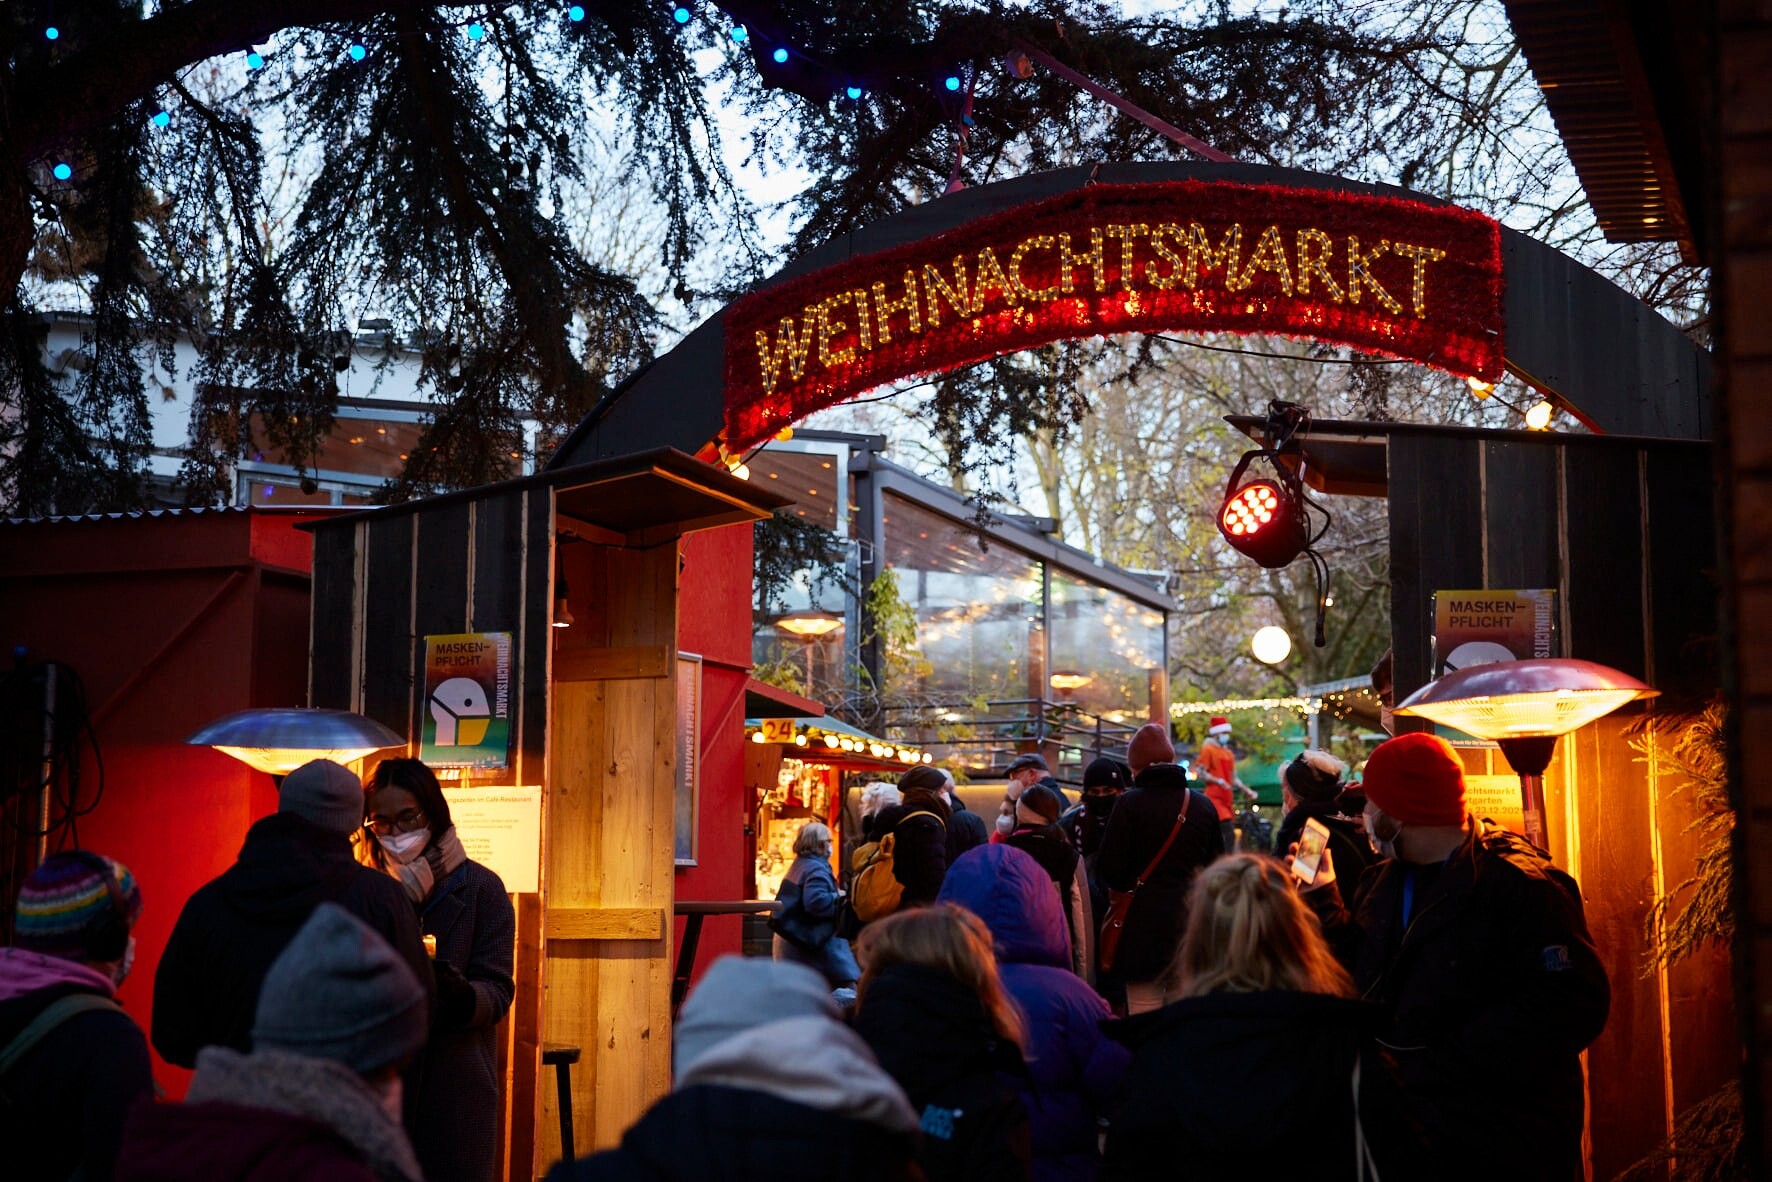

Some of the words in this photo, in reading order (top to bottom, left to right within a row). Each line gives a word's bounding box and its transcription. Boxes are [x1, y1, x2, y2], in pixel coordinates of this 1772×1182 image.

[755, 221, 1447, 395] WEIHNACHTSMARKT
[1449, 601, 1526, 613] MASKEN-
[1449, 616, 1514, 628] PFLICHT
[1534, 593, 1550, 658] WEIHNACHTS
[436, 642, 490, 654] MASKEN-
[435, 655, 481, 666] PFLICHT
[496, 634, 509, 719] WEIHNACHTSMARKT
[764, 720, 792, 740] 24
[1465, 787, 1515, 796] chtsmarkt
